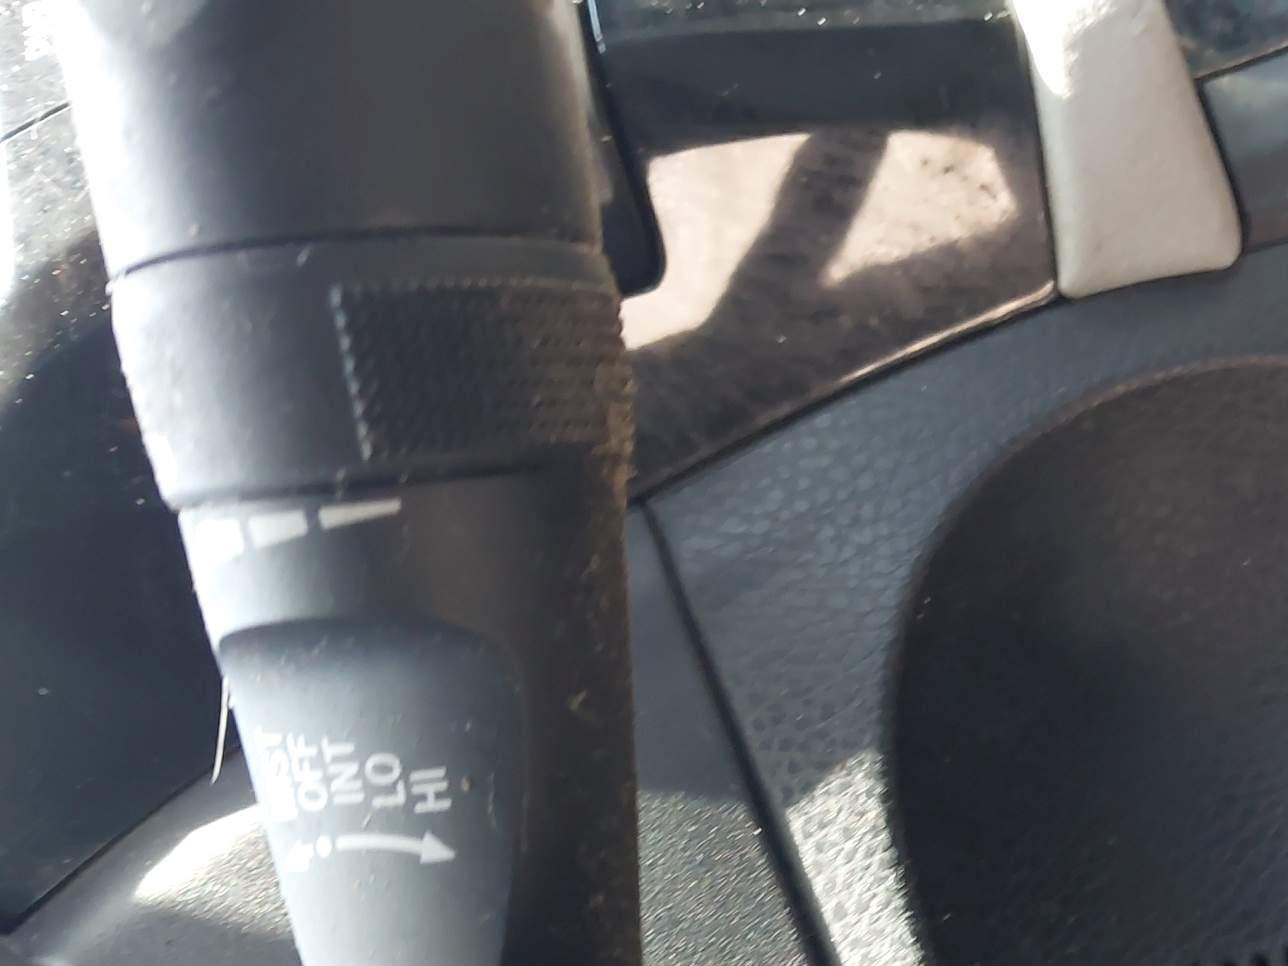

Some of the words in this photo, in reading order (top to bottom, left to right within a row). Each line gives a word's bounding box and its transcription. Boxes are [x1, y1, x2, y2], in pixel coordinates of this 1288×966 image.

[285, 732, 329, 812] OFF
[321, 735, 365, 805] INT
[364, 752, 405, 809] LO
[409, 766, 452, 814] HI
